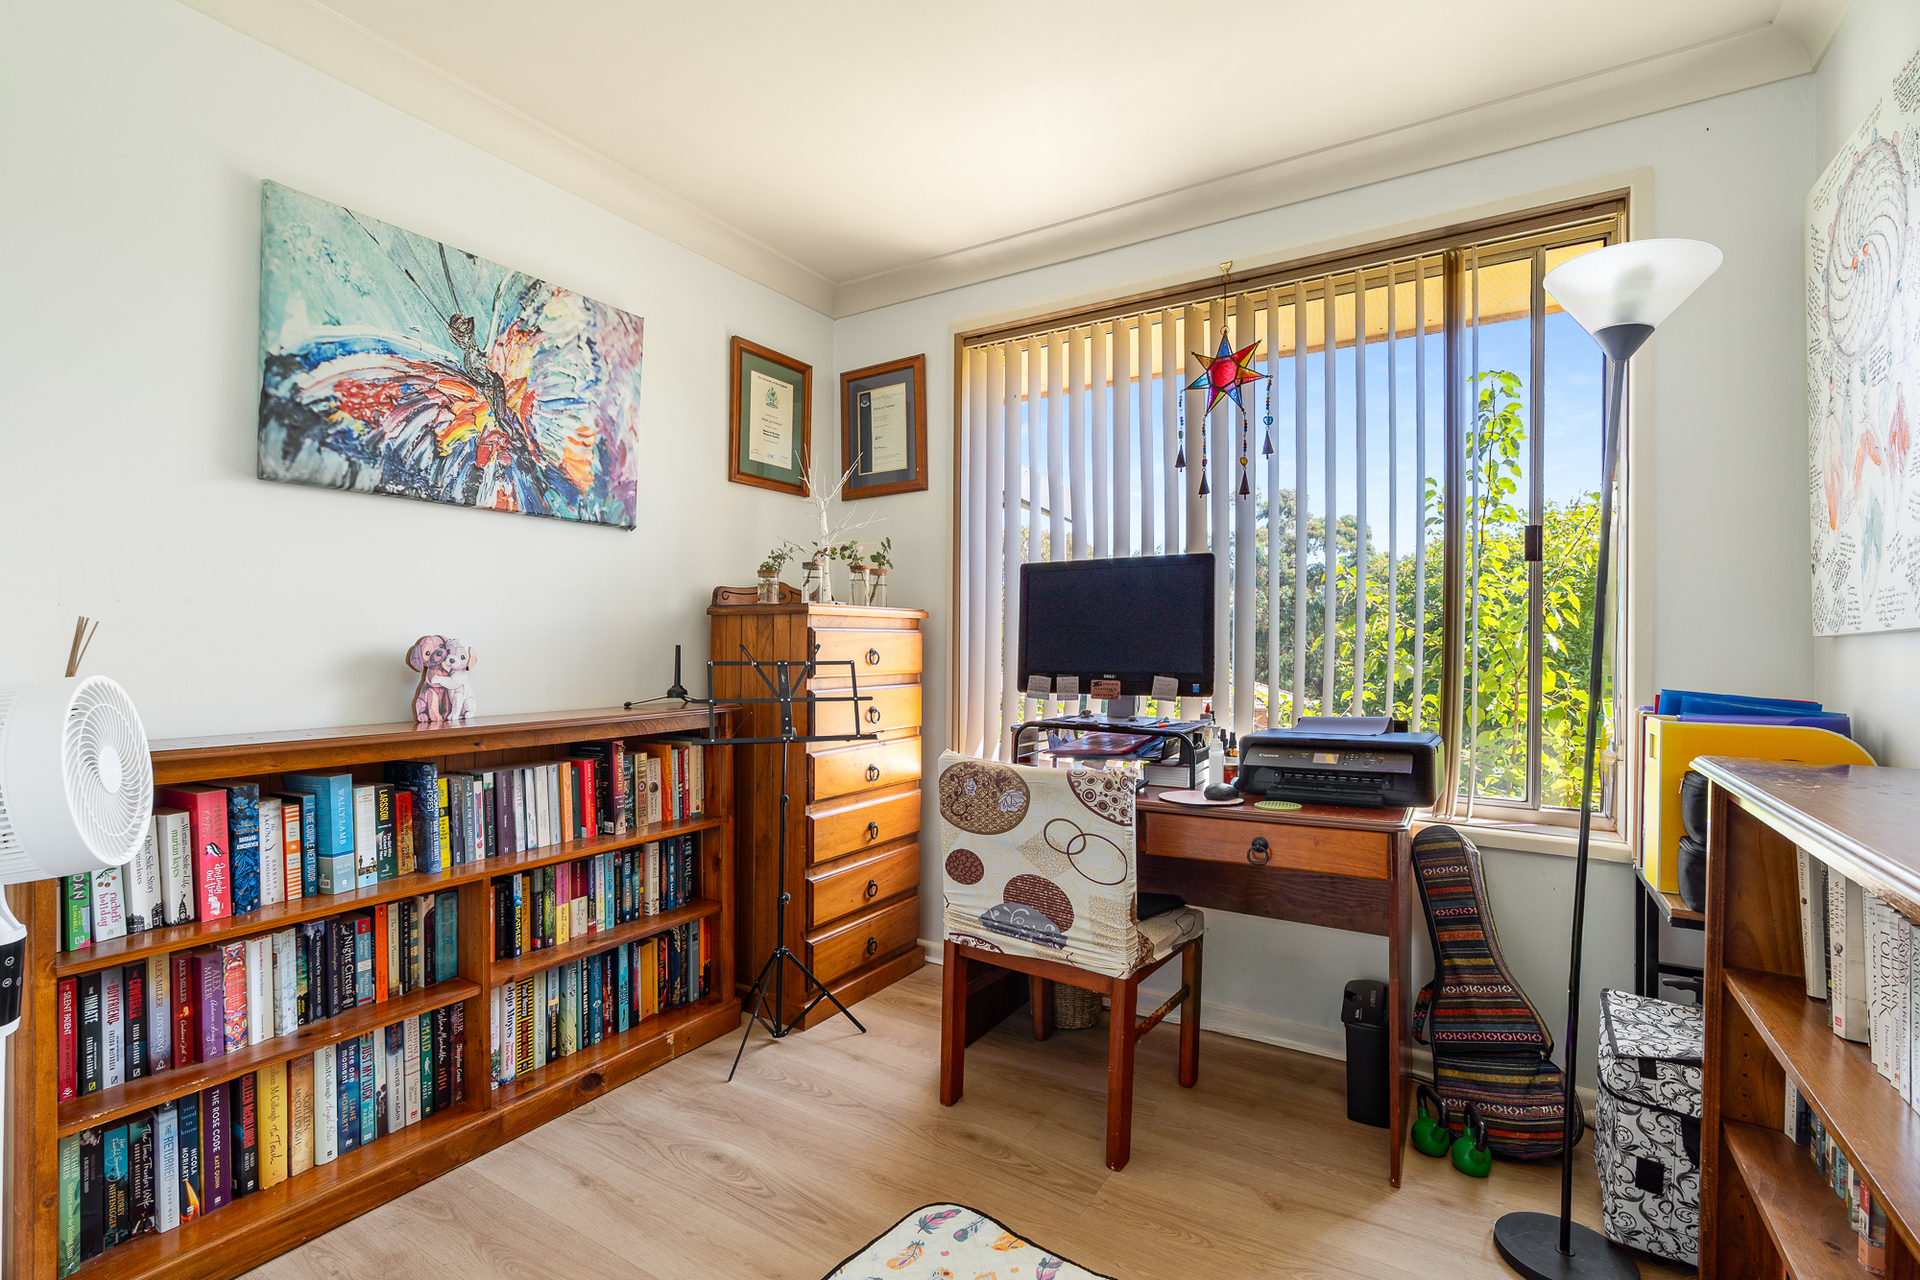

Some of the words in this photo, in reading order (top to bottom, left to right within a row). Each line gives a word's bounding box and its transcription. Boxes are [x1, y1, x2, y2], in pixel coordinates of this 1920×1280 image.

[306, 812, 314, 824] THE
[379, 789, 389, 821] LARSSON
[202, 810, 213, 837] KEYES
[213, 804, 223, 840] MARIAN
[264, 814, 272, 843] LACUNA
[339, 819, 347, 845] LAMB
[144, 835, 152, 854] Other
[172, 830, 181, 856] marian
[306, 824, 315, 848] COUPLE
[146, 856, 154, 870] Side
[172, 856, 181, 878] keyes
[307, 848, 316, 864] NEXT
[651, 849, 659, 878] Uprooted
[135, 867, 143, 885] keyes
[146, 876, 155, 893] Story
[206, 870, 216, 882] Out
[307, 864, 316, 882] DOOR
[97, 892, 110, 926] holiday
[110, 892, 122, 923] rachel's
[342, 935, 354, 963] Night
[1898, 928, 1906, 985] GRAHAM
[204, 966, 213, 1000] MILLER
[212, 970, 220, 992] ALEX
[345, 964, 354, 994] Circus
[1879, 931, 1891, 1018] POLDARK
[1890, 937, 1899, 1013] POLDARK
[84, 994, 98, 1025] INMATE
[107, 984, 119, 1024] BOYFRIEND
[129, 979, 142, 1019] COWORKER
[505, 987, 515, 1007] Jojo
[132, 1024, 140, 1040] FREIDA
[156, 1011, 164, 1052] LOVESONG
[438, 1008, 448, 1030] Melina
[505, 1008, 515, 1038] Moyes
[422, 1026, 431, 1052] MAID
[362, 1045, 372, 1064] JUST
[270, 1065, 279, 1085] Colleen
[362, 1064, 372, 1078] MY
[242, 1074, 254, 1105] COLLEEN
[362, 1079, 372, 1102] LUCK
[181, 1111, 197, 1120] need
[212, 1107, 220, 1128] ROSE
[294, 1088, 302, 1145] McCULLOUGH
[322, 1101, 336, 1125] Angel
[141, 1124, 151, 1142] The
[243, 1104, 255, 1149] McCULLOUGH
[143, 1138, 152, 1161] Time
[163, 1136, 174, 1181] RETURNED
[269, 1134, 283, 1165] Touch
[62, 1147, 70, 1180] MORRIS
[136, 1189, 154, 1208] Wife
[66, 1226, 74, 1244] Rising
